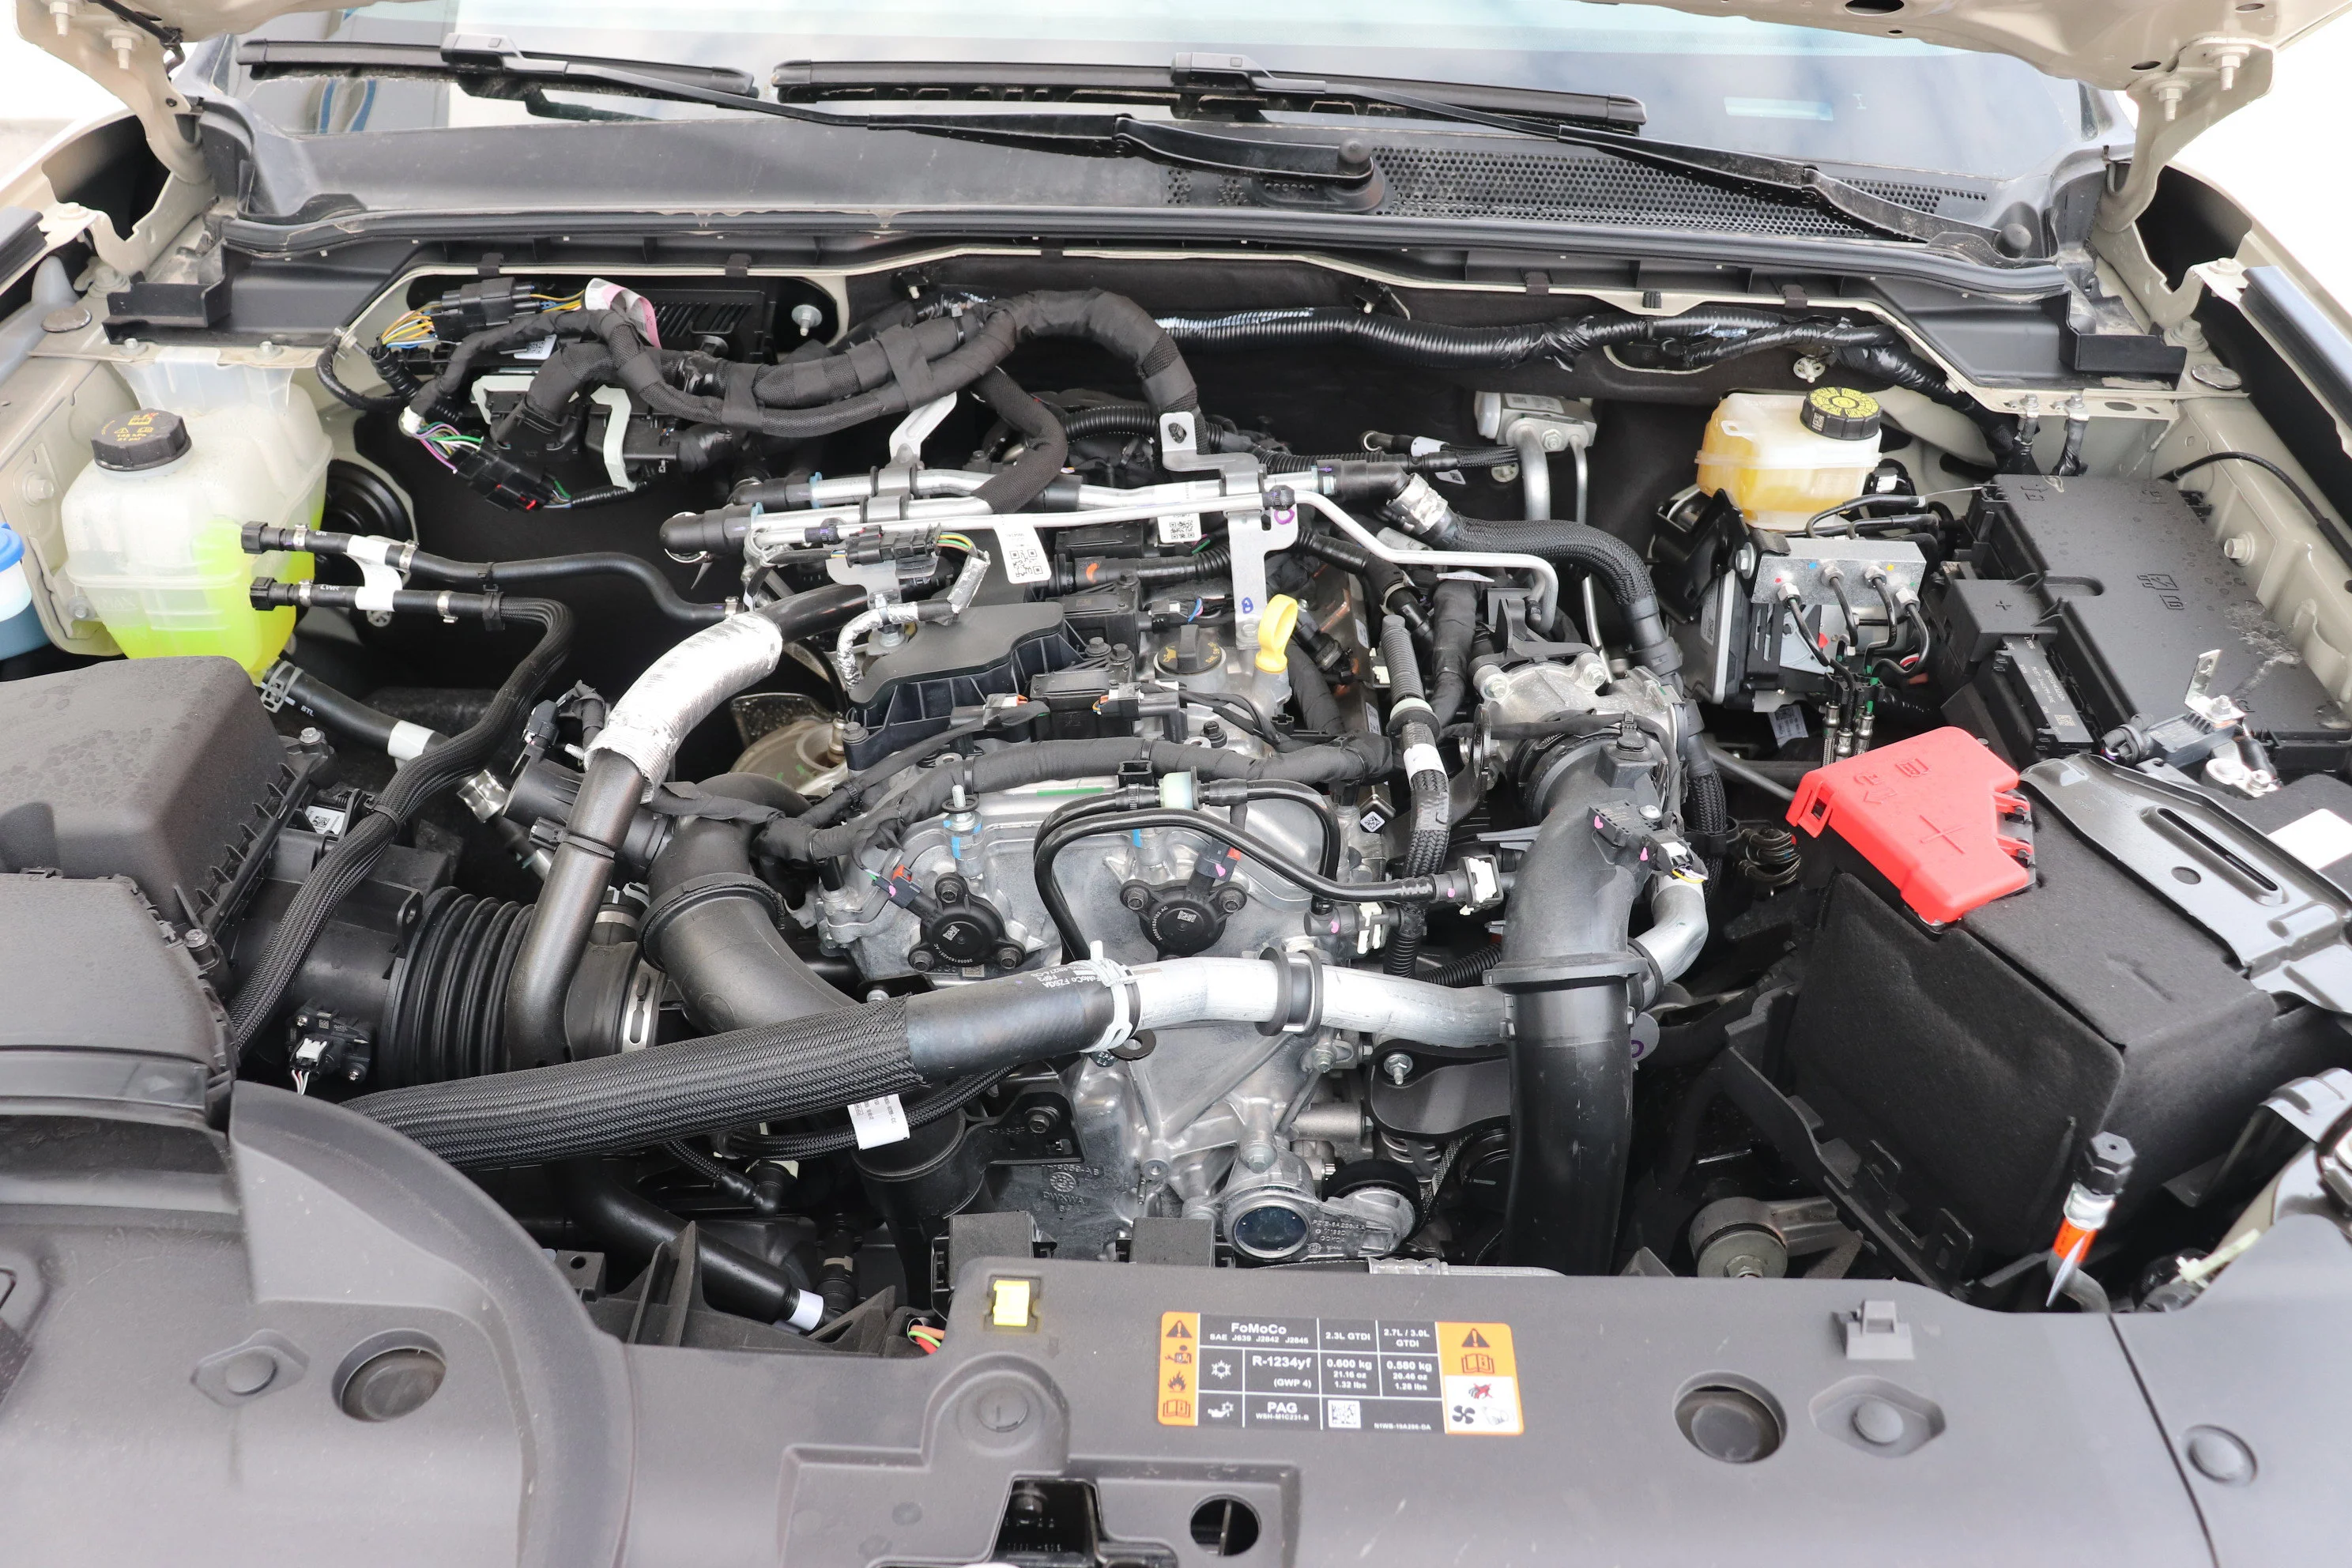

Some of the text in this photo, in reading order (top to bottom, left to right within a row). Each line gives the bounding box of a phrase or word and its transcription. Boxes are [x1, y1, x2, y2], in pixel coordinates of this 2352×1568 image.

[1231, 1322, 1287, 1335] FoMoCo
[1325, 1332, 1371, 1341] 2.3L GTDI
[1383, 1329, 1404, 1337] 2.7L
[1410, 1329, 1430, 1338] 3.0L
[1396, 1339, 1419, 1348] GTDI
[1252, 1355, 1312, 1370] R-1234yf
[1326, 1358, 1373, 1371] 0.600 kg
[1418, 1361, 1432, 1373] kg
[1333, 1370, 1355, 1379] 21.16
[1393, 1372, 1415, 1381] 20.46
[1273, 1378, 1312, 1389] (GWP 4)
[1334, 1381, 1366, 1389] 1.32 lbs
[1395, 1382, 1412, 1391] 1.28
[1267, 1401, 1298, 1414] PAG
